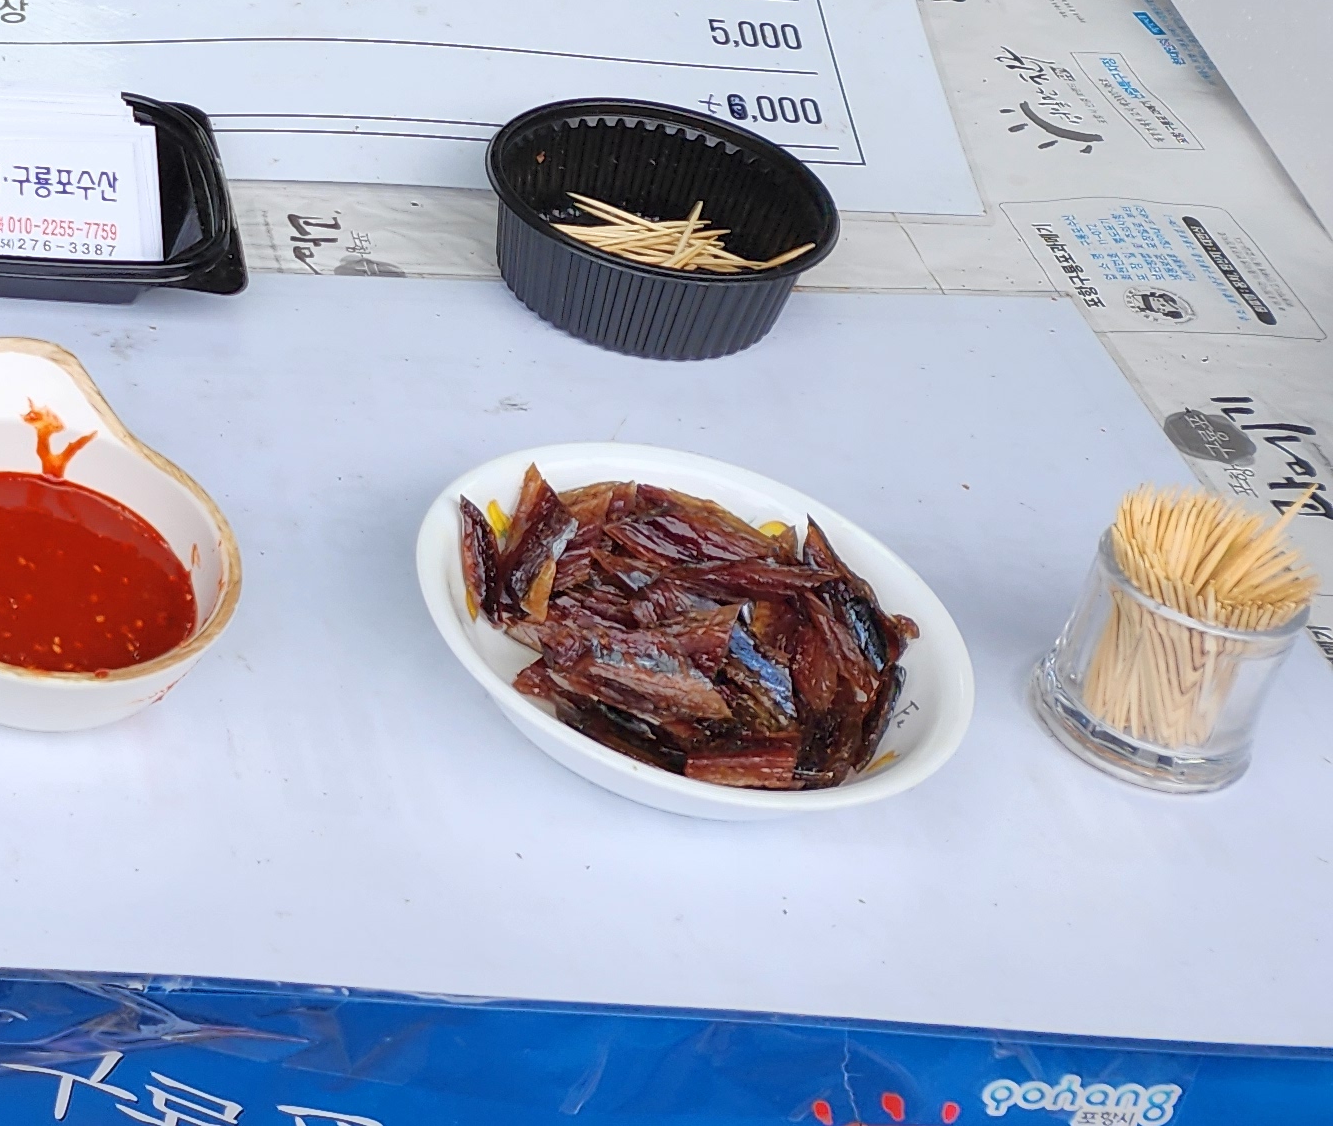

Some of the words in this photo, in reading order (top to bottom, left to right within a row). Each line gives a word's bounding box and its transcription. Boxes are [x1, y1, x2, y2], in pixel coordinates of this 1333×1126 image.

[708, 18, 802, 51] 5,000
[8, 216, 118, 241] 010-2255-7759
[1028, 222, 1108, 307] 포항구룡포과메기
